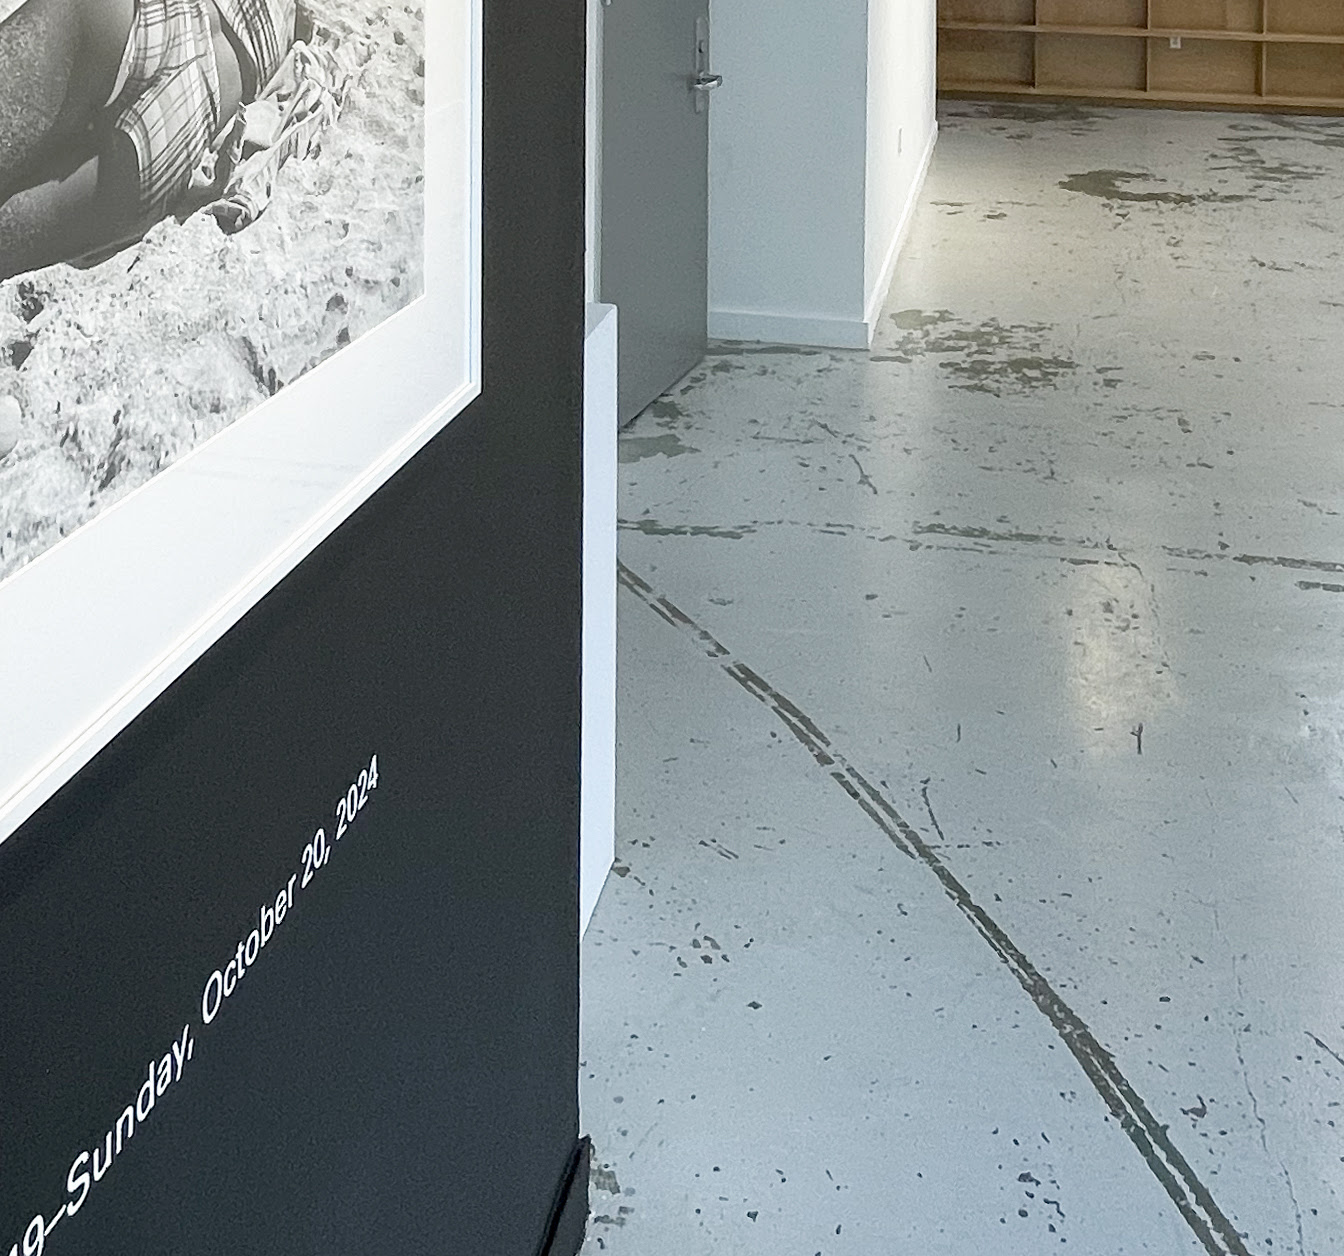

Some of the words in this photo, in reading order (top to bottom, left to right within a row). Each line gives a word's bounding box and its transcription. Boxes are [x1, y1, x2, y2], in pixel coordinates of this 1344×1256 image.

[8, 1022, 194, 1256] 9–Sunday,
[202, 873, 297, 1024] October
[301, 828, 332, 889] 20,
[335, 754, 379, 841] 2024
